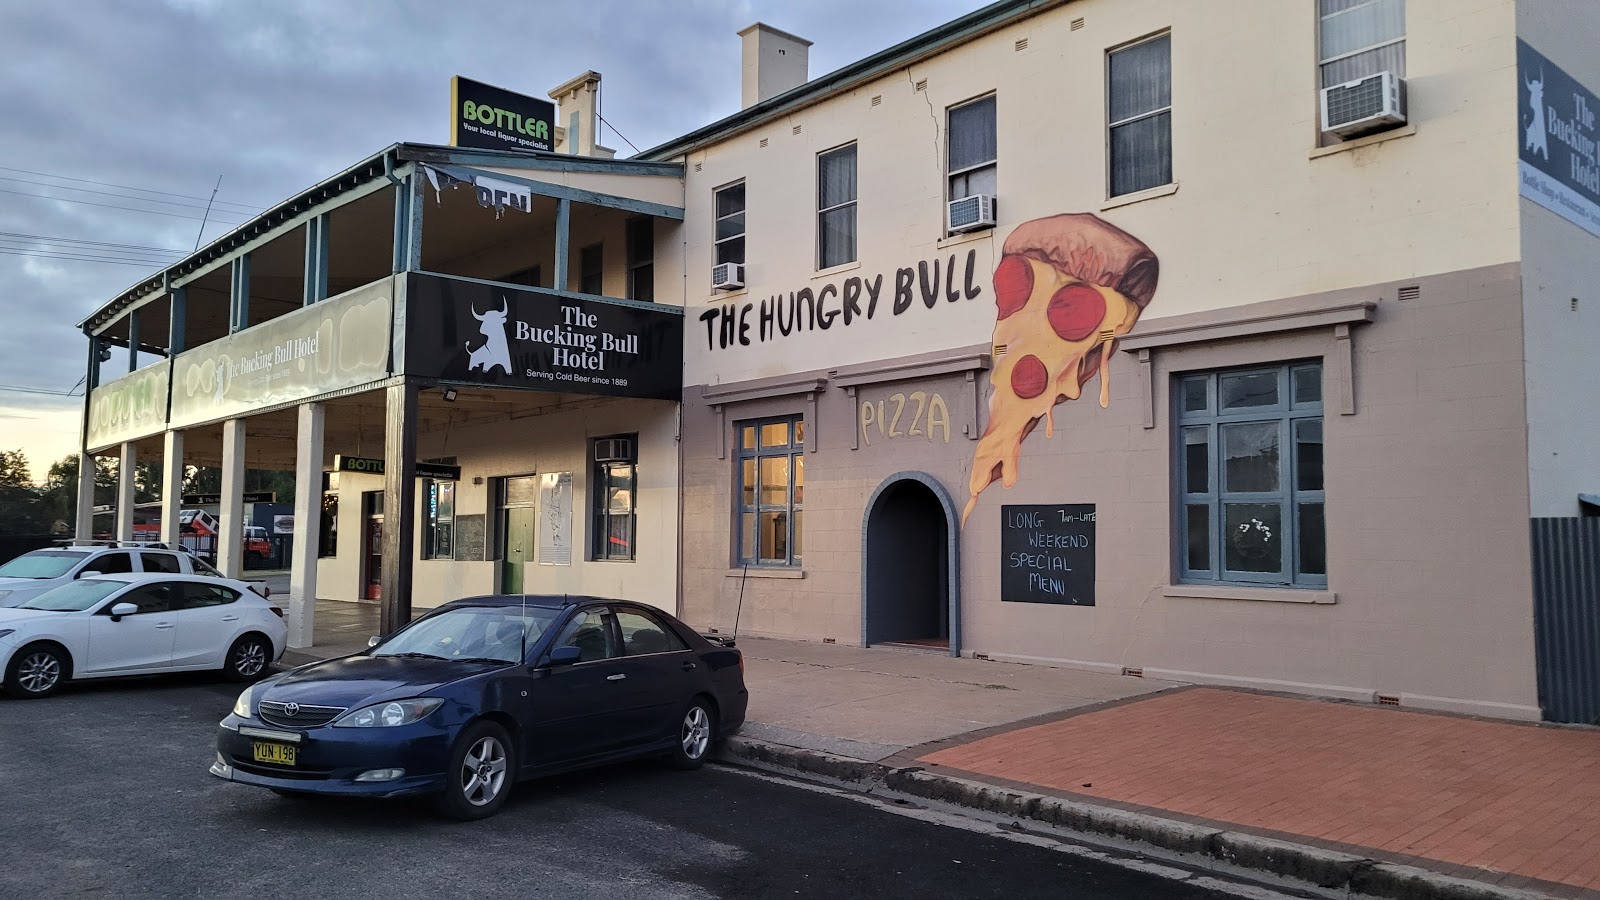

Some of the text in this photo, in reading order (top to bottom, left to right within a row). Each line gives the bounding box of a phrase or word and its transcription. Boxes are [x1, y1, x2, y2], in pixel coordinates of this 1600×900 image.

[463, 100, 548, 140] BOTTLER
[1573, 92, 1595, 131] The
[463, 122, 548, 150] Your local liquor specialist
[1547, 105, 1595, 166] Bucking
[1570, 152, 1600, 195] Hotel
[476, 185, 527, 212] PEN
[699, 249, 981, 351] THE HUNGRY BULL
[561, 305, 598, 329] The
[515, 320, 639, 355] Bucking Bull
[226, 330, 319, 379] The Bucking Bull Hotel
[552, 347, 604, 371] Hotel
[526, 368, 628, 387] Serving Cold Beer since 1889
[860, 390, 951, 447] PIZZA
[347, 458, 385, 472] BOTTL
[1008, 510, 1045, 529] LONG
[1028, 532, 1089, 548] WEEKEND
[1009, 550, 1072, 571] SPECIAL
[1029, 572, 1066, 596] MENU
